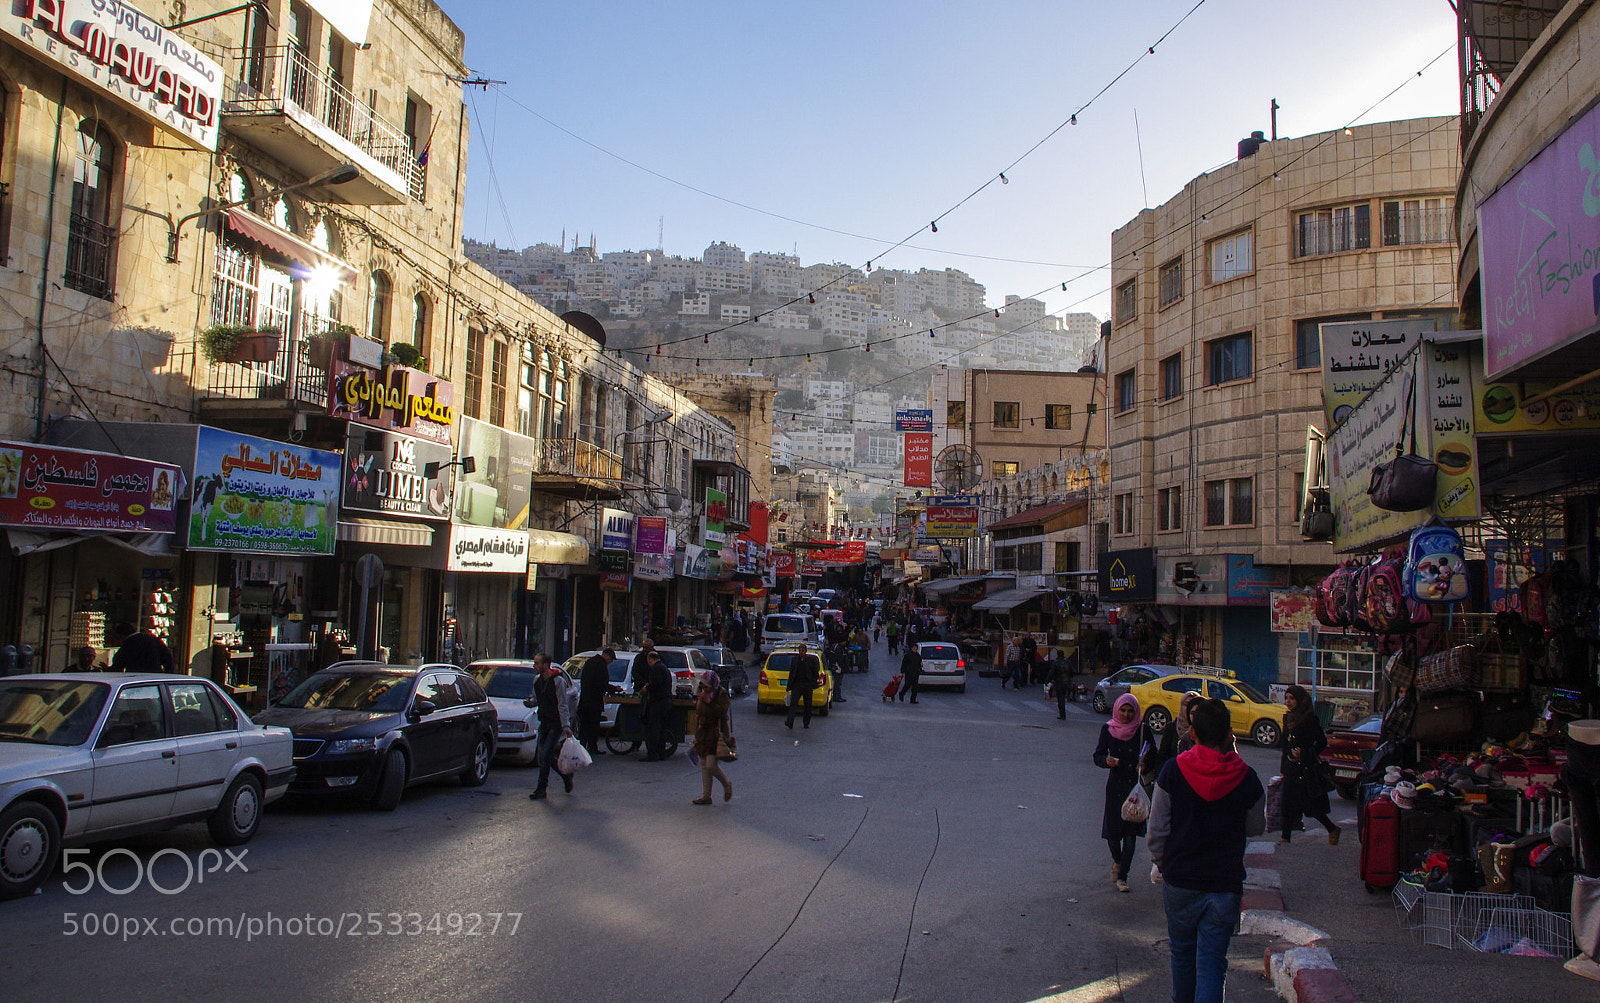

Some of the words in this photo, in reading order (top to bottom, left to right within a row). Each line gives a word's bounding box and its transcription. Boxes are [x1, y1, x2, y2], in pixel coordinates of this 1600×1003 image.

[90, 0, 162, 47] الماوردي
[28, 0, 216, 127] ALMAWARDI
[164, 38, 215, 83] مطعم
[20, 22, 209, 142] RESTAURANT
[1351, 330, 1406, 348] محلات
[1330, 352, 1380, 373] للشنط
[1435, 349, 1460, 363] محلات
[1436, 372, 1460, 389] سمارو
[345, 363, 414, 428] الماوردي
[413, 381, 454, 426] مطعم
[1438, 393, 1462, 408] للشنط
[23, 453, 99, 494] فلسطين
[280, 448, 322, 482] محلات
[391, 460, 417, 474] COSMETICS
[102, 472, 150, 498] محمص
[375, 468, 429, 503] LIMEI
[380, 499, 400, 511] BEAUTY
[405, 501, 422, 513] CLEAN
[455, 537, 484, 559] المصري
[505, 536, 524, 557] شركة
